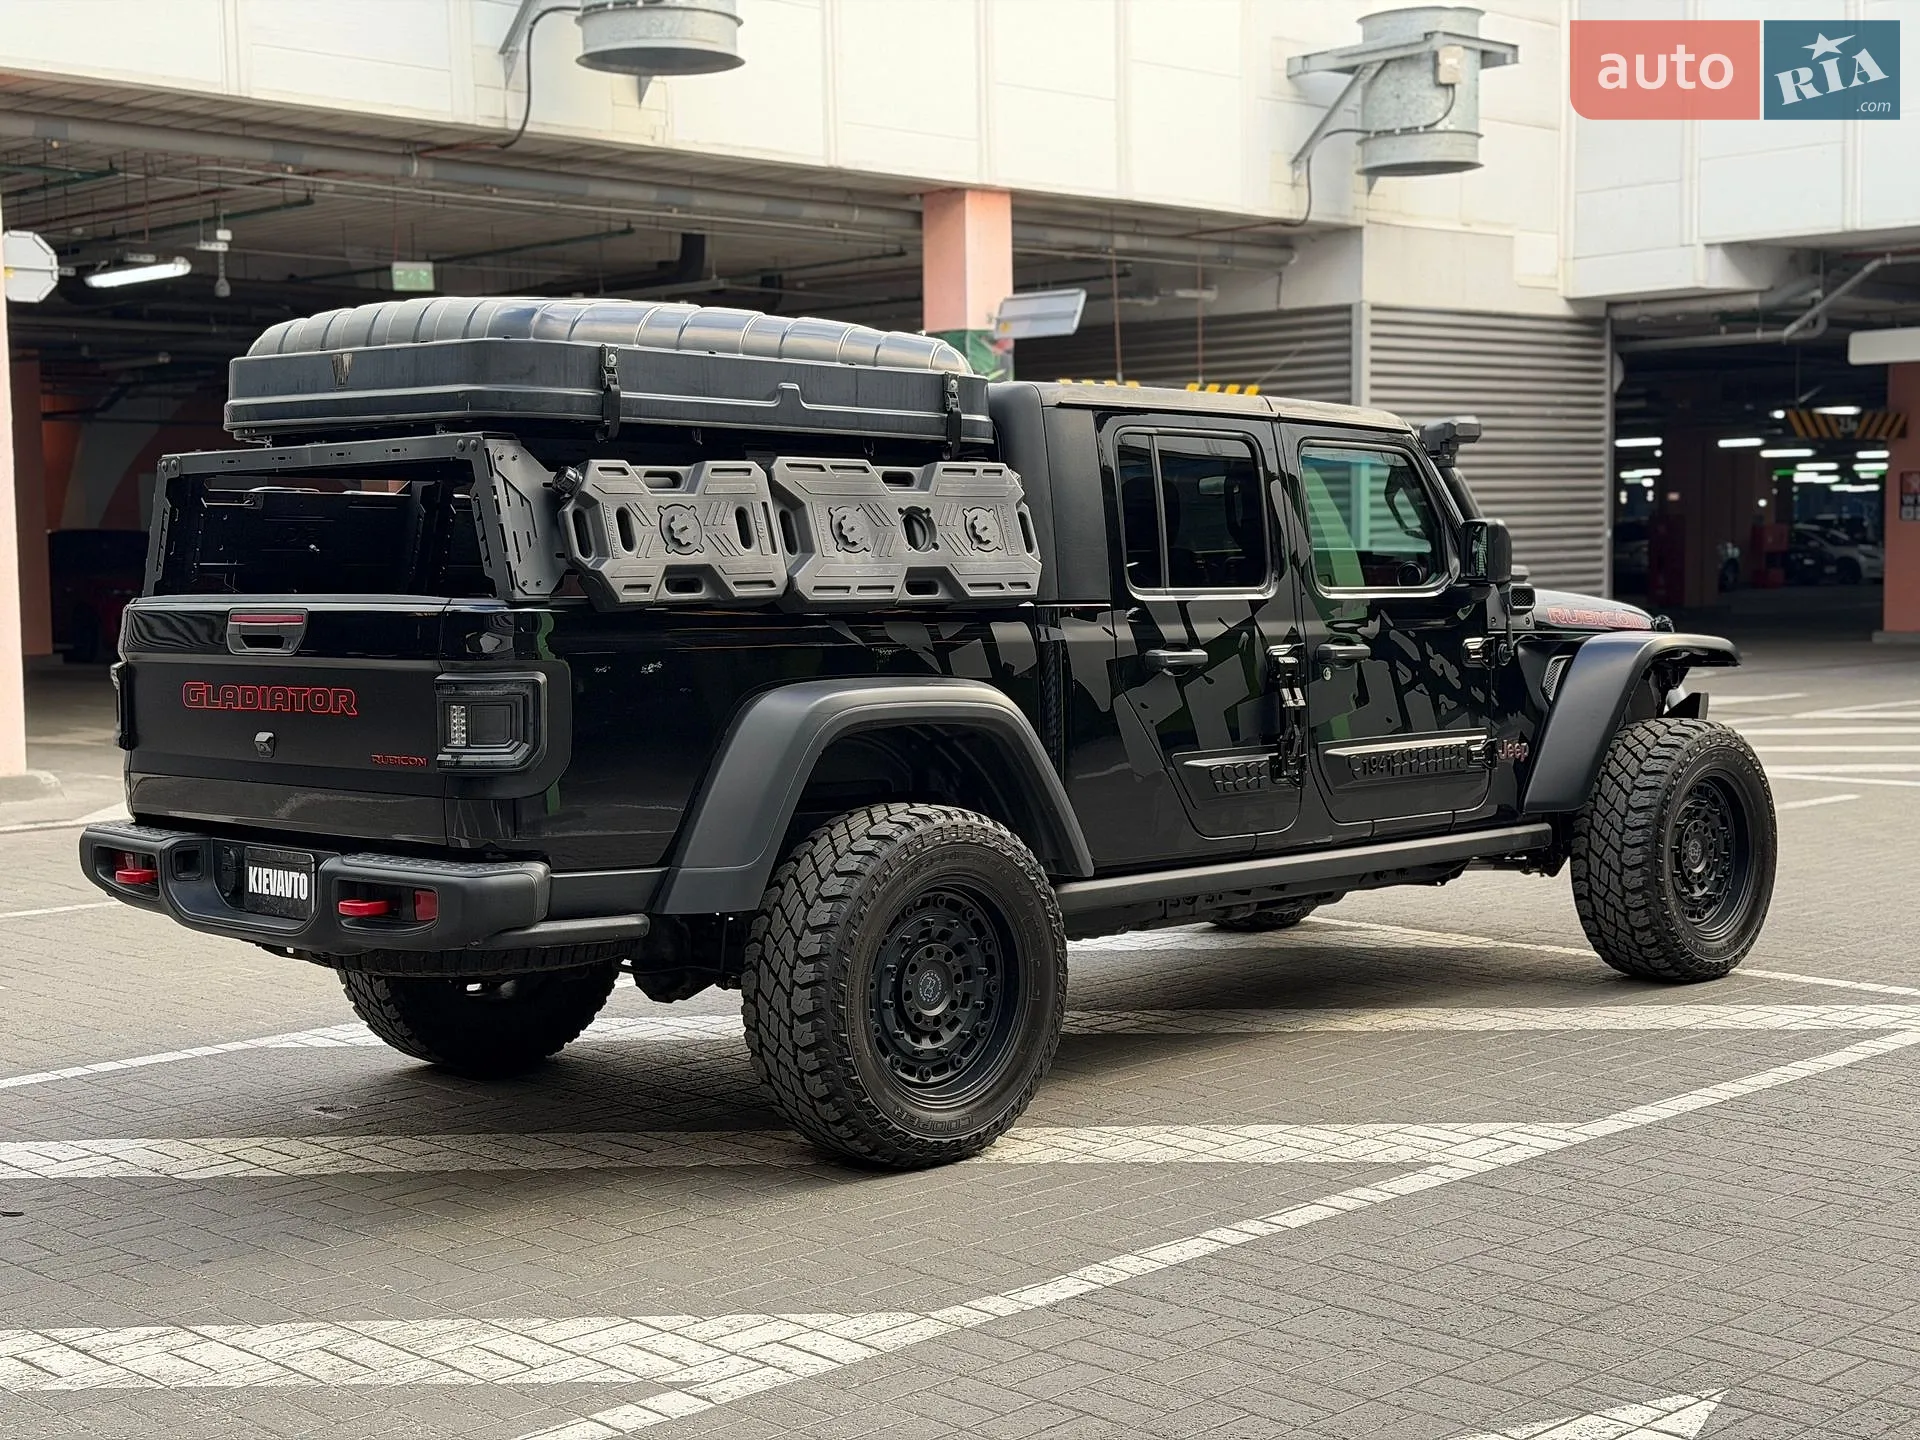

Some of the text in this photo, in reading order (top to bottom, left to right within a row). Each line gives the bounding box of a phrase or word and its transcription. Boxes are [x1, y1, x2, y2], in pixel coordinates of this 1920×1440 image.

[182, 681, 358, 717] GLADIATOR
[371, 754, 429, 767] RUBICON
[1498, 739, 1530, 762] Jeep
[248, 866, 308, 900] KIEVAVTO
